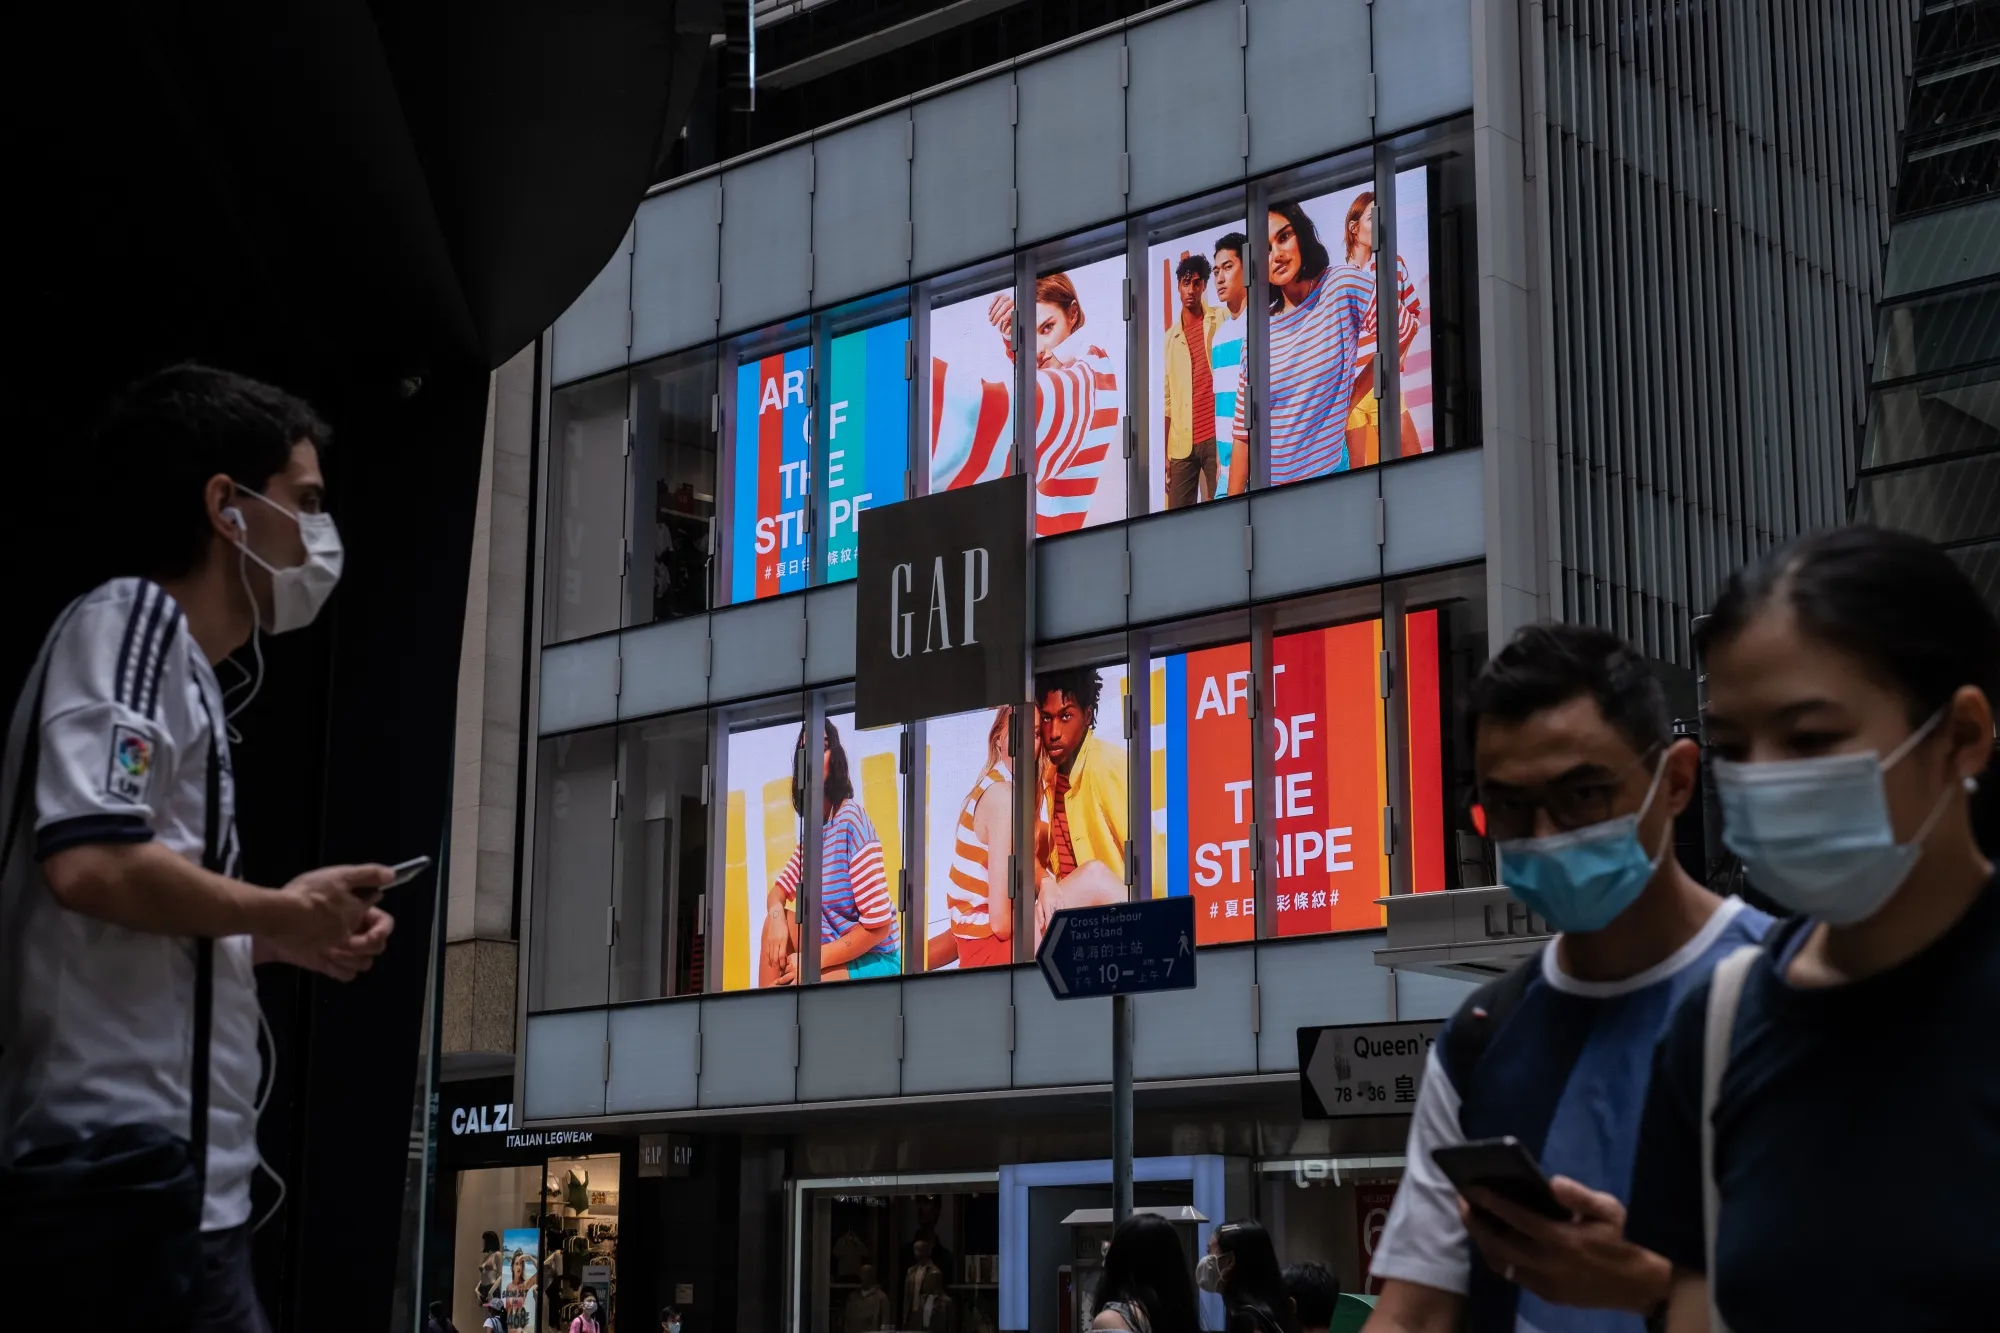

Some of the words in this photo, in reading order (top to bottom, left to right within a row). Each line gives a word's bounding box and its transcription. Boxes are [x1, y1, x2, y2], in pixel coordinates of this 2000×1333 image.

[759, 369, 804, 415] AR
[890, 547, 989, 659] GAP
[1209, 889, 1340, 919] #夏日彩條紋#
[1070, 917, 1099, 928] Cross
[1101, 912, 1142, 925] Harbour
[1484, 903, 1556, 937] LH
[1071, 930, 1090, 941] Taxi
[1093, 926, 1123, 938] Stand
[1072, 940, 1143, 961] 過海的士站
[1076, 965, 1090, 975] pm
[1162, 958, 1175, 979] 7
[1394, 1074, 1417, 1103] 皇
[506, 1134, 543, 1148] ITALIAN
[544, 1131, 593, 1145] LEGWEAR
[645, 1146, 662, 1165] GAP
[674, 1146, 693, 1165] GAP
